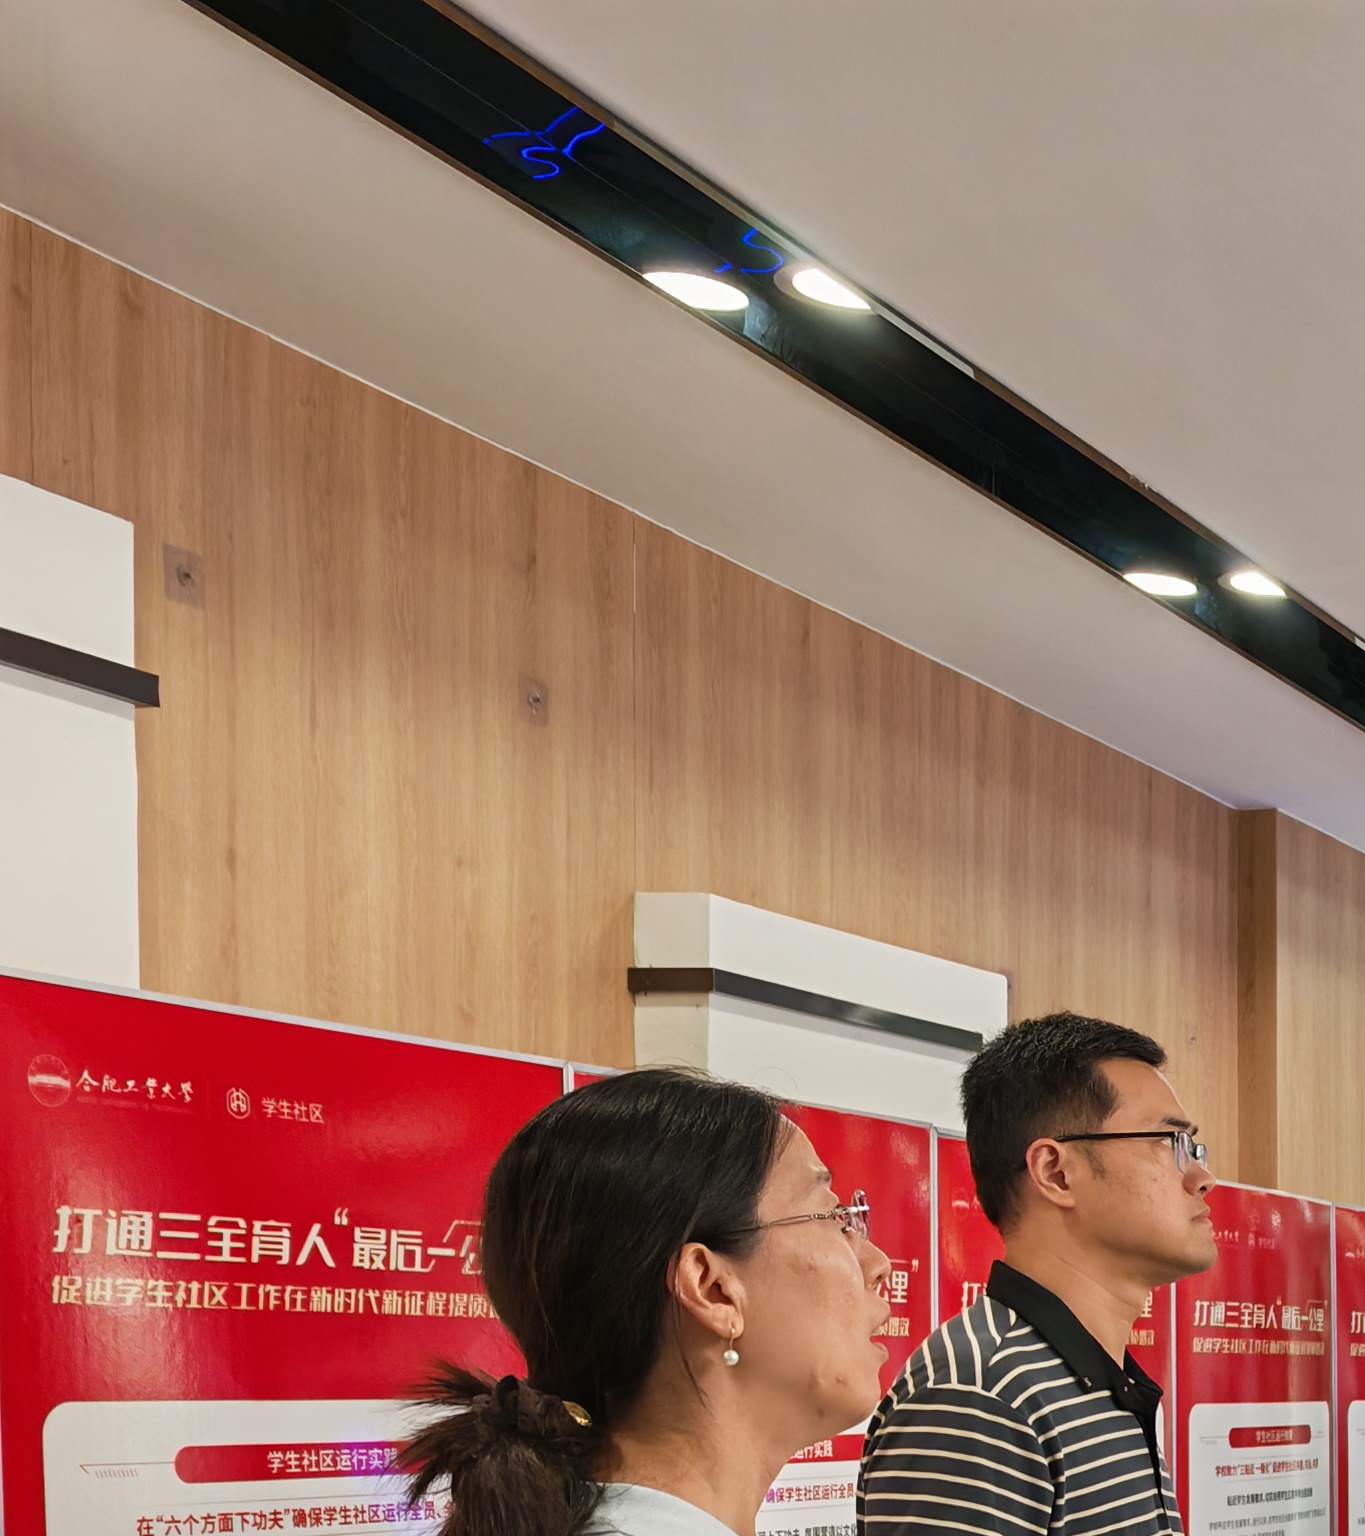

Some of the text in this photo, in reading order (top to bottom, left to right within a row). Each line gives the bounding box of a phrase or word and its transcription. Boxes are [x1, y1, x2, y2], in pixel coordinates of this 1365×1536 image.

[261, 1096, 324, 1124] 学生社区
[52, 1275, 500, 1319] 促进学生社区工作在新时代新征程提质
